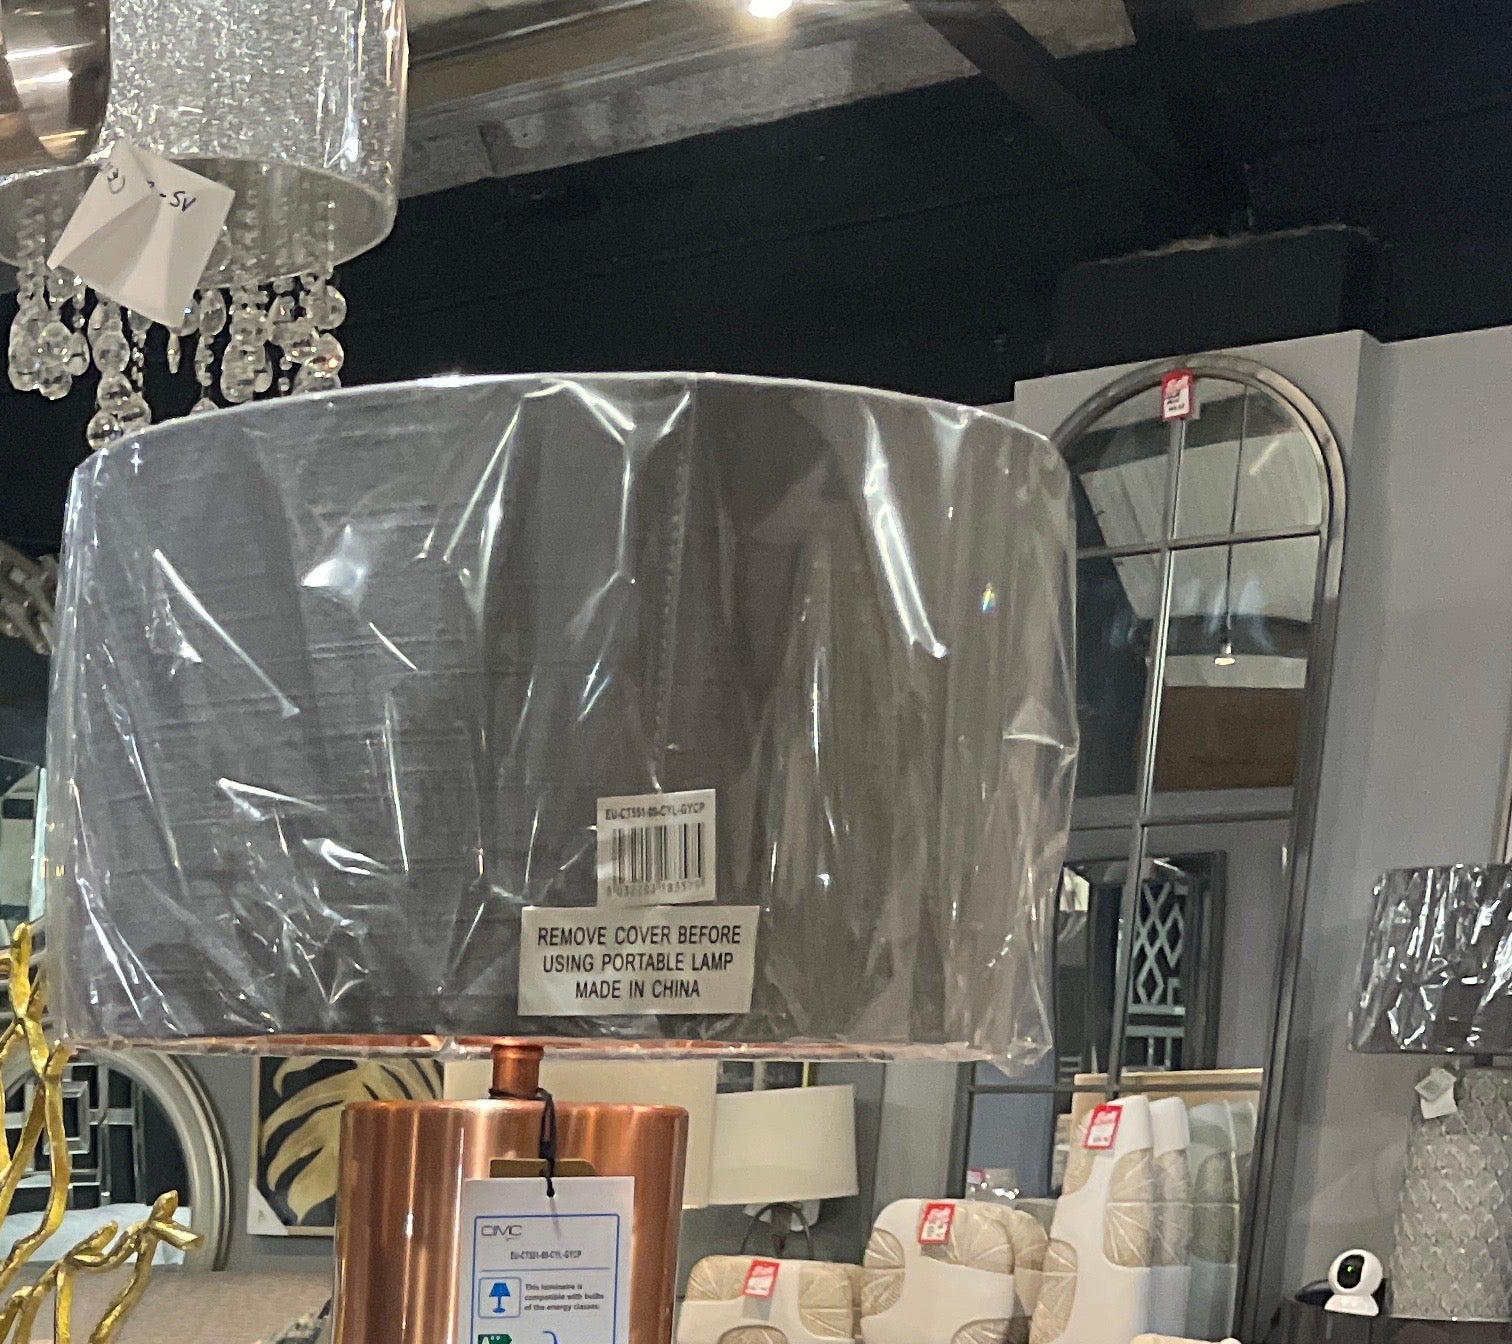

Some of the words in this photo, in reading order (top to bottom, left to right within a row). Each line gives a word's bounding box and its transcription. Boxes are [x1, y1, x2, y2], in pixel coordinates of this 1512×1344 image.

[537, 926, 607, 946] REMOVE
[615, 925, 671, 945] COVER
[678, 924, 742, 944] BEFORE
[543, 953, 594, 973] USING
[601, 952, 684, 972] PORTABLE
[691, 951, 734, 971] LAMP
[575, 979, 621, 999] MADE
[629, 979, 645, 998] IN
[652, 979, 701, 998] CHINA
